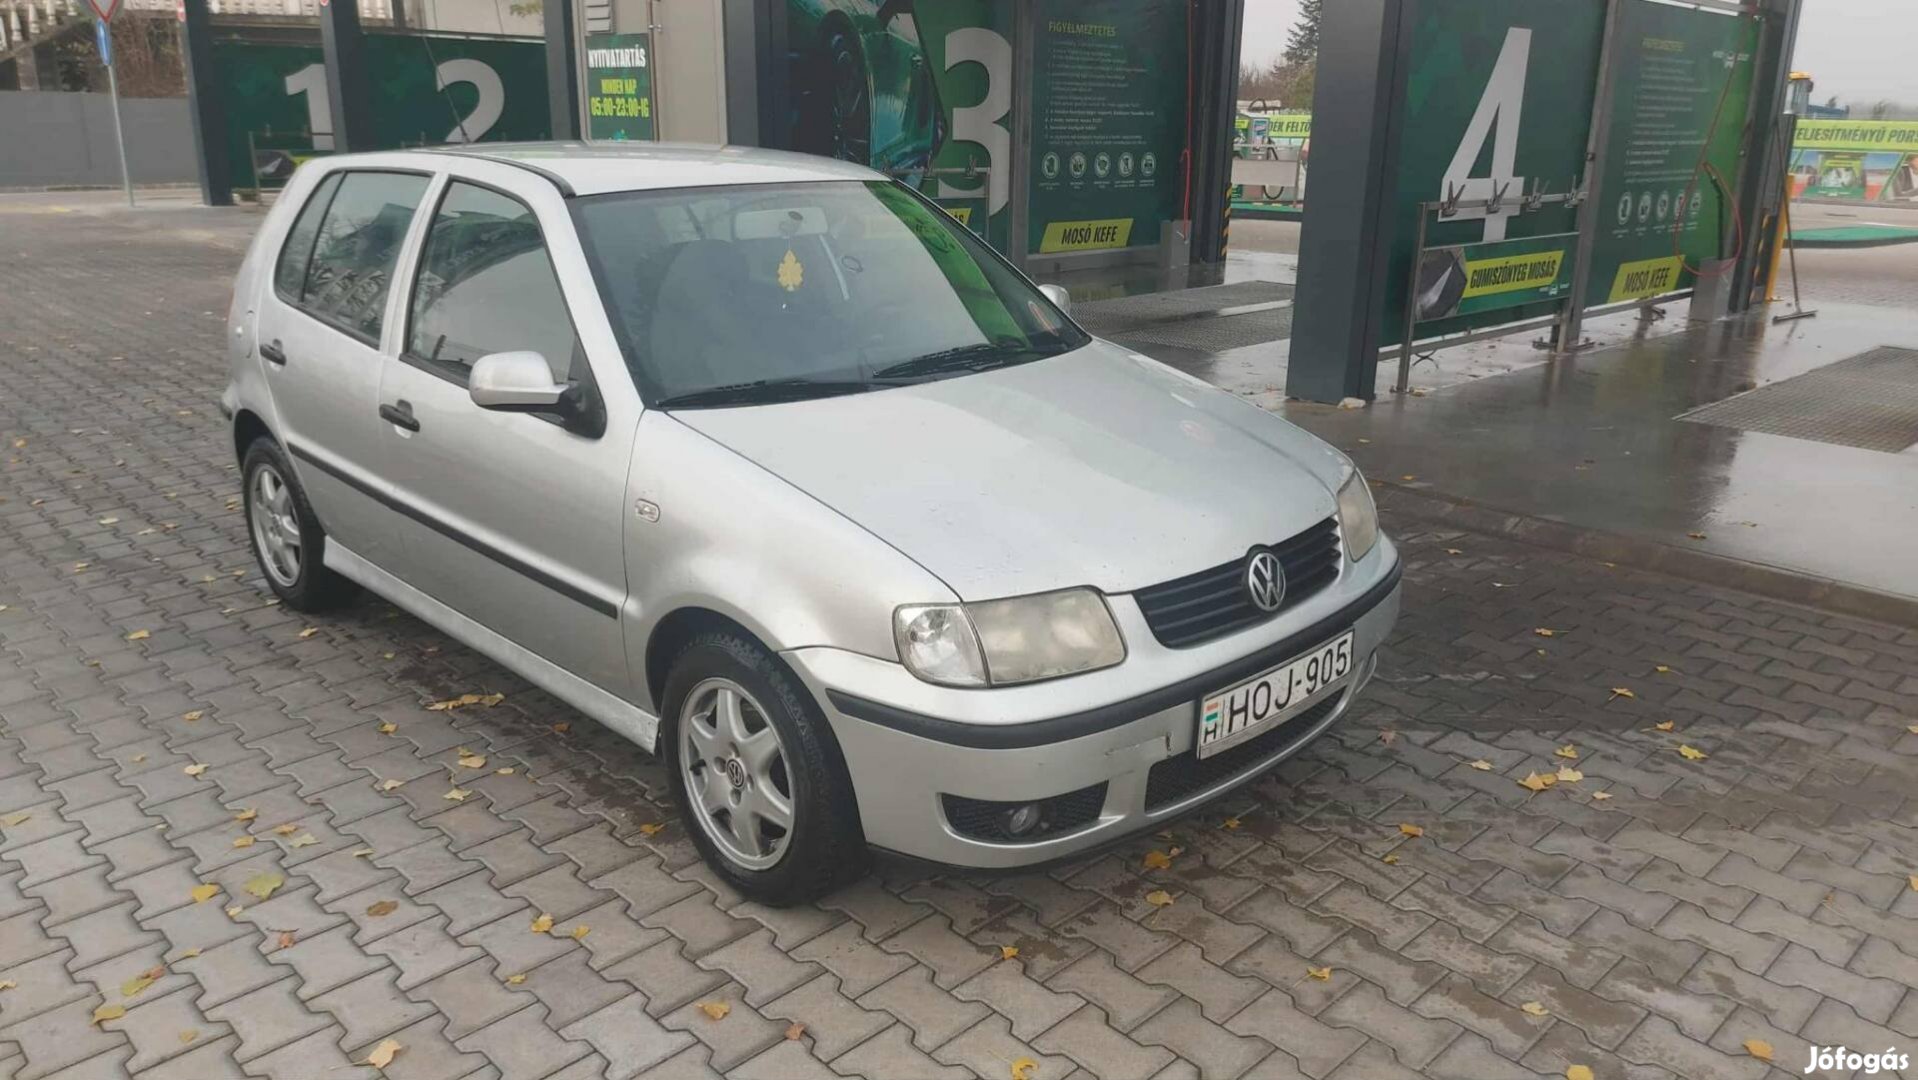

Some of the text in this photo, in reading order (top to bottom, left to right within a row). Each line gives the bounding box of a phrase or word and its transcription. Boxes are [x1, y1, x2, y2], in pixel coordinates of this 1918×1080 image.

[588, 44, 646, 68] NYITVATARTÁS
[285, 63, 335, 150] 1
[436, 58, 504, 144] 2
[938, 27, 1012, 216] 3
[1438, 26, 1532, 242] 4
[1061, 224, 1118, 245] MOSÓ KEFE
[1528, 256, 1557, 280] MOSÁS
[1227, 638, 1349, 734] HOJ-905
[1204, 723, 1217, 743] H
